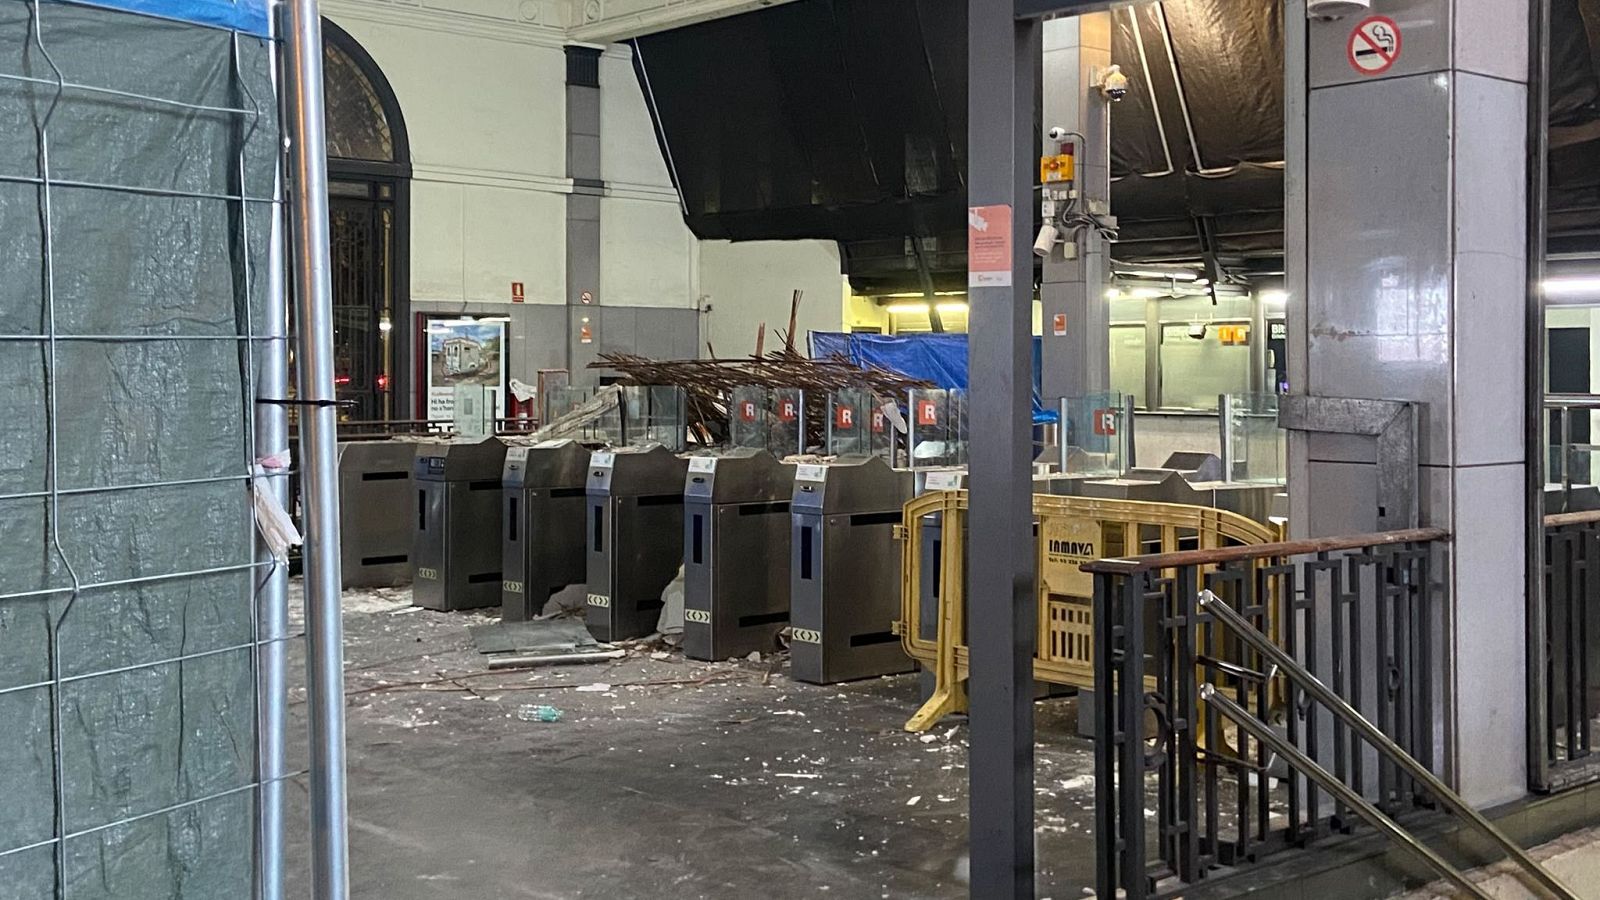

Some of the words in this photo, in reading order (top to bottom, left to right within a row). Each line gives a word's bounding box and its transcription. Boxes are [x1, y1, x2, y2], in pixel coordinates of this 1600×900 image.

[745, 403, 754, 417] R
[784, 403, 793, 417] R
[842, 409, 852, 424] R
[925, 405, 936, 419] R
[873, 413, 884, 427] R
[1101, 413, 1115, 430] R
